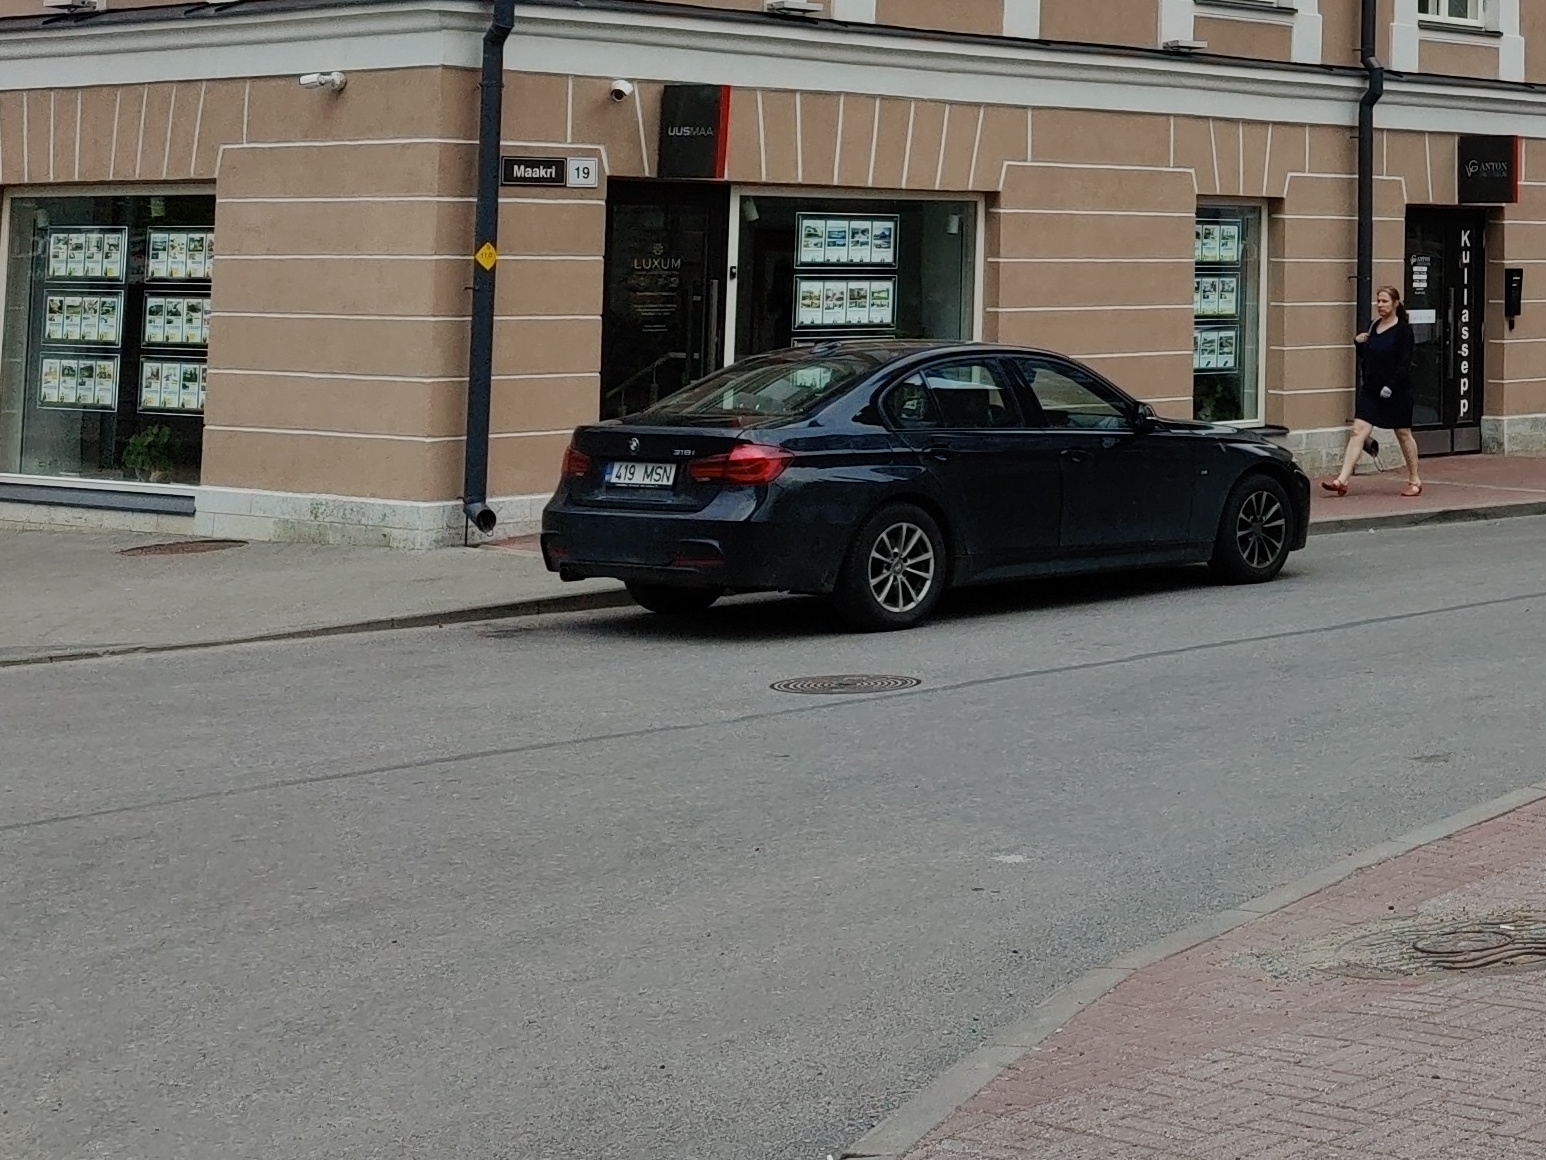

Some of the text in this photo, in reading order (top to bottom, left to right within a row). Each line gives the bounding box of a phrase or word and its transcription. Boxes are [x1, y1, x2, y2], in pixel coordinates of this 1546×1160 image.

[513, 164, 590, 179] Maakri 19
[633, 257, 681, 269] LUXUM
[1459, 229, 1471, 417] Kullassepp
[614, 464, 673, 483] 419 MSN
